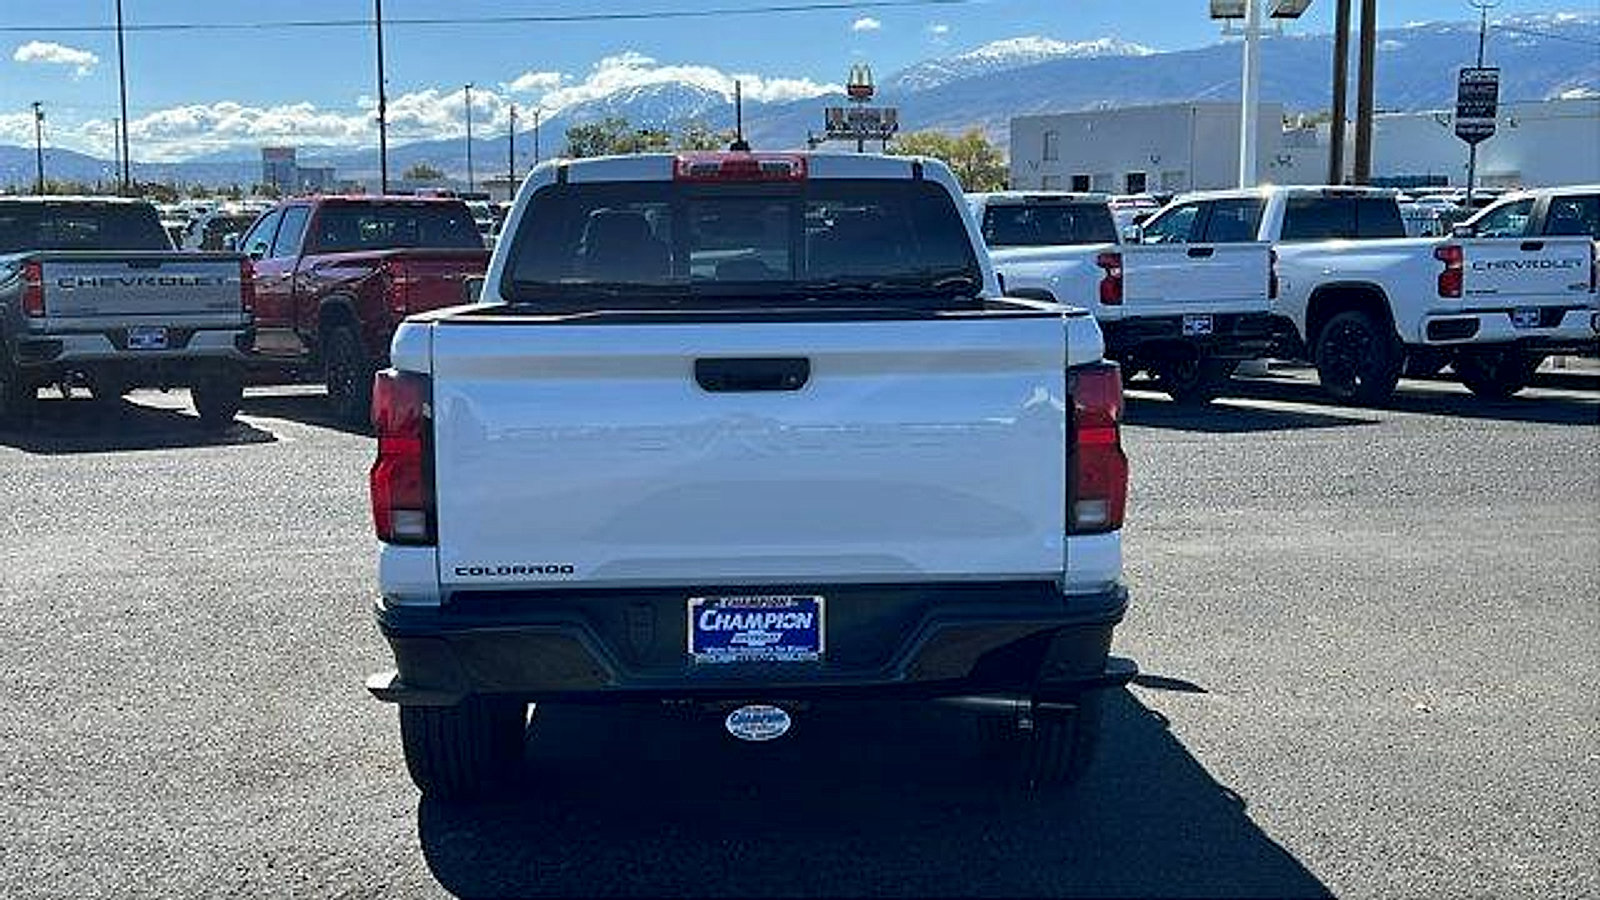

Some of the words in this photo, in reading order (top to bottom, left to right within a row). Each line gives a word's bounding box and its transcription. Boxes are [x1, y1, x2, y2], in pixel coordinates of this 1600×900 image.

[1472, 257, 1584, 271] CHEVROLET
[57, 275, 234, 289] CHEVROLET
[454, 565, 575, 577] COLORADO
[699, 609, 814, 631] CHAMPION
